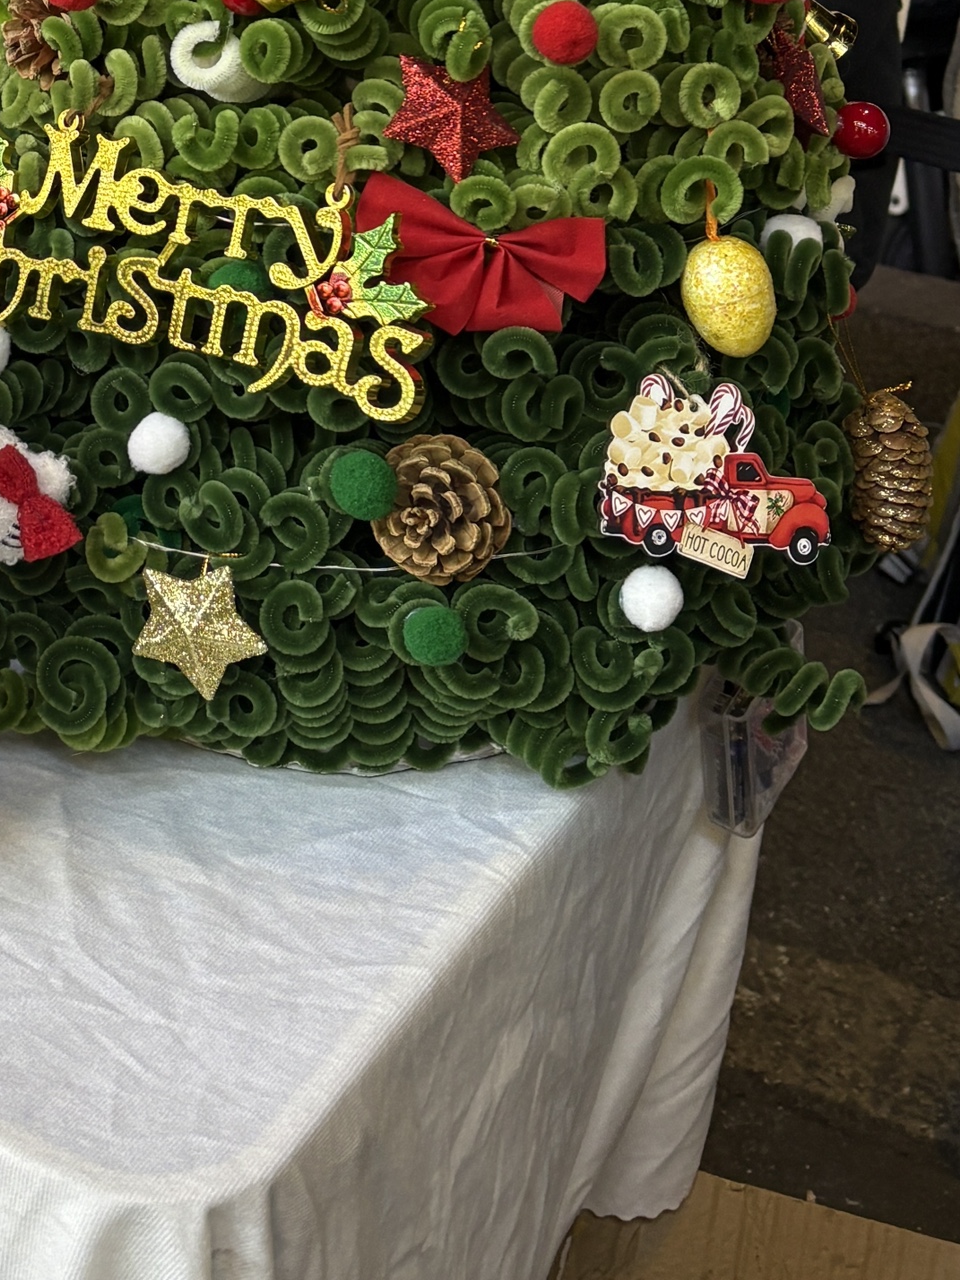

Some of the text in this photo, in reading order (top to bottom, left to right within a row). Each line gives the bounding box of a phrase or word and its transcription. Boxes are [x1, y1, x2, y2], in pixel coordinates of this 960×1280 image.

[20, 122, 346, 289] Merry
[684, 531, 747, 571] HOT COCOA
